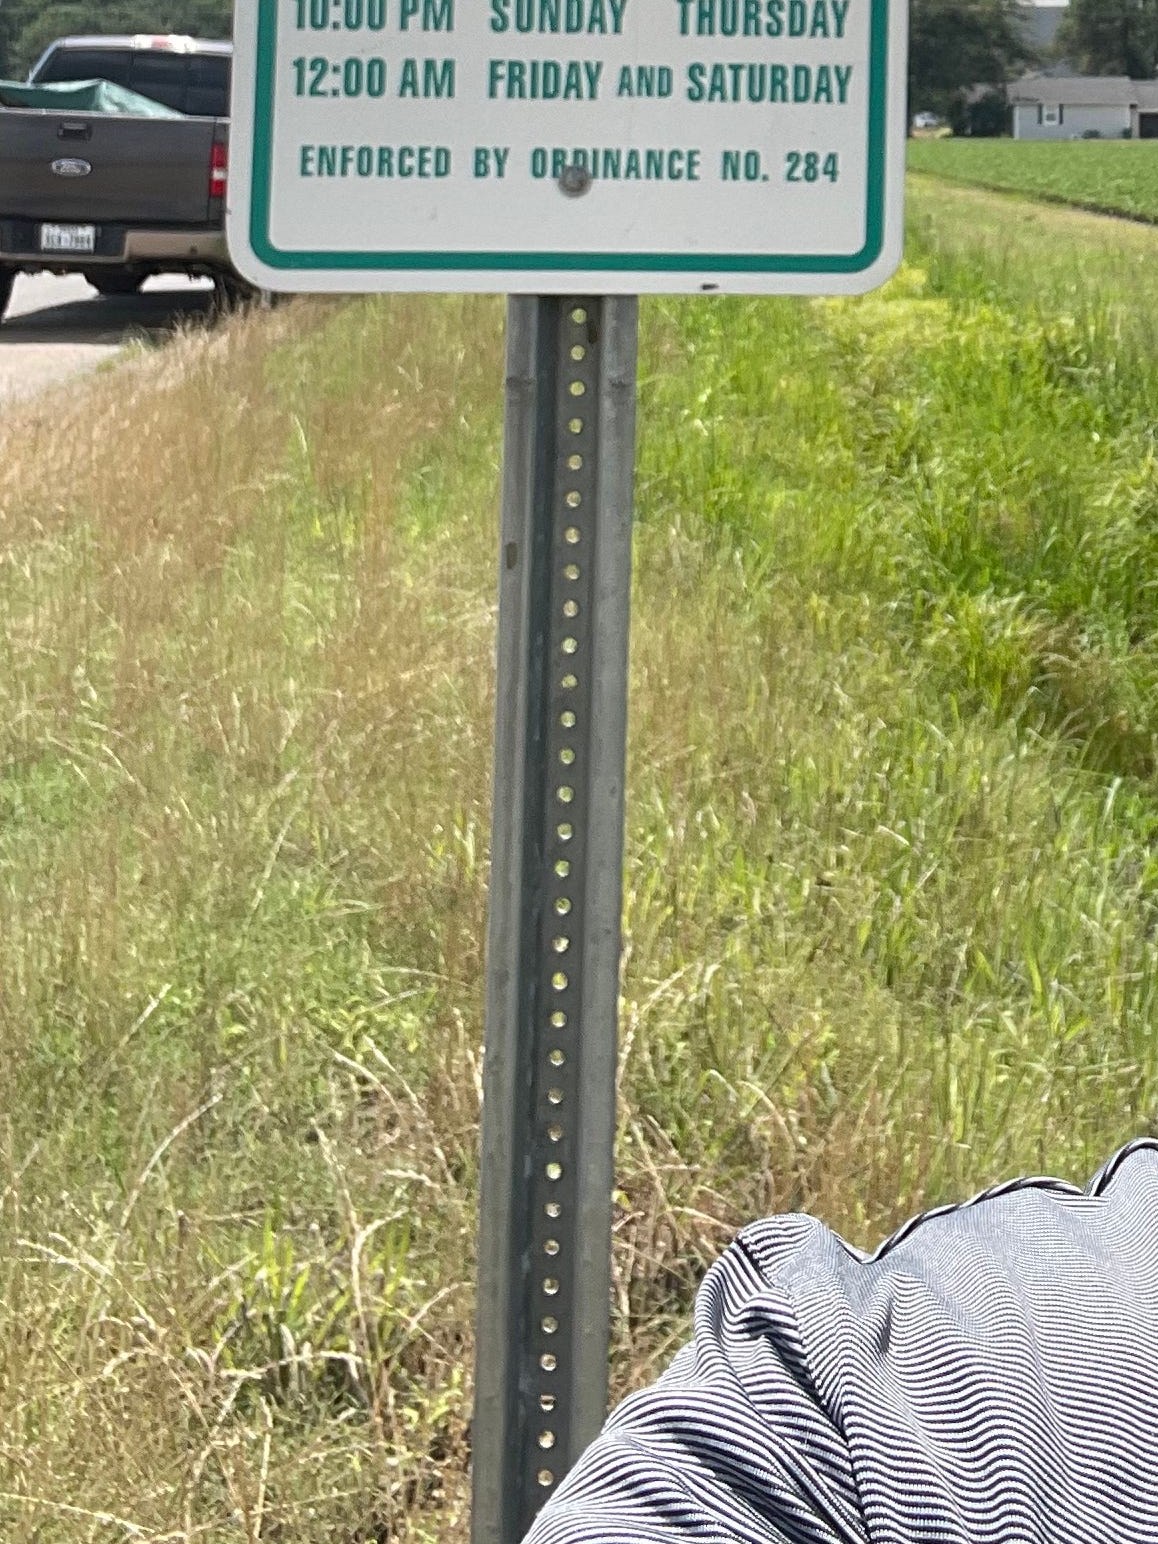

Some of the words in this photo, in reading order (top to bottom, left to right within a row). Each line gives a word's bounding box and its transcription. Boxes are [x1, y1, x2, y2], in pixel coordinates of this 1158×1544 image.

[293, 58, 387, 98] 12:00
[399, 59, 455, 98] AM
[488, 61, 602, 100] FRIDAY
[617, 66, 673, 98] AND
[687, 63, 853, 104] SATURDAY
[300, 146, 452, 178] ENFORCED
[473, 148, 510, 179] BY
[531, 148, 700, 181] ORDINANCE
[722, 151, 769, 182] NO.
[785, 152, 840, 183] 284
